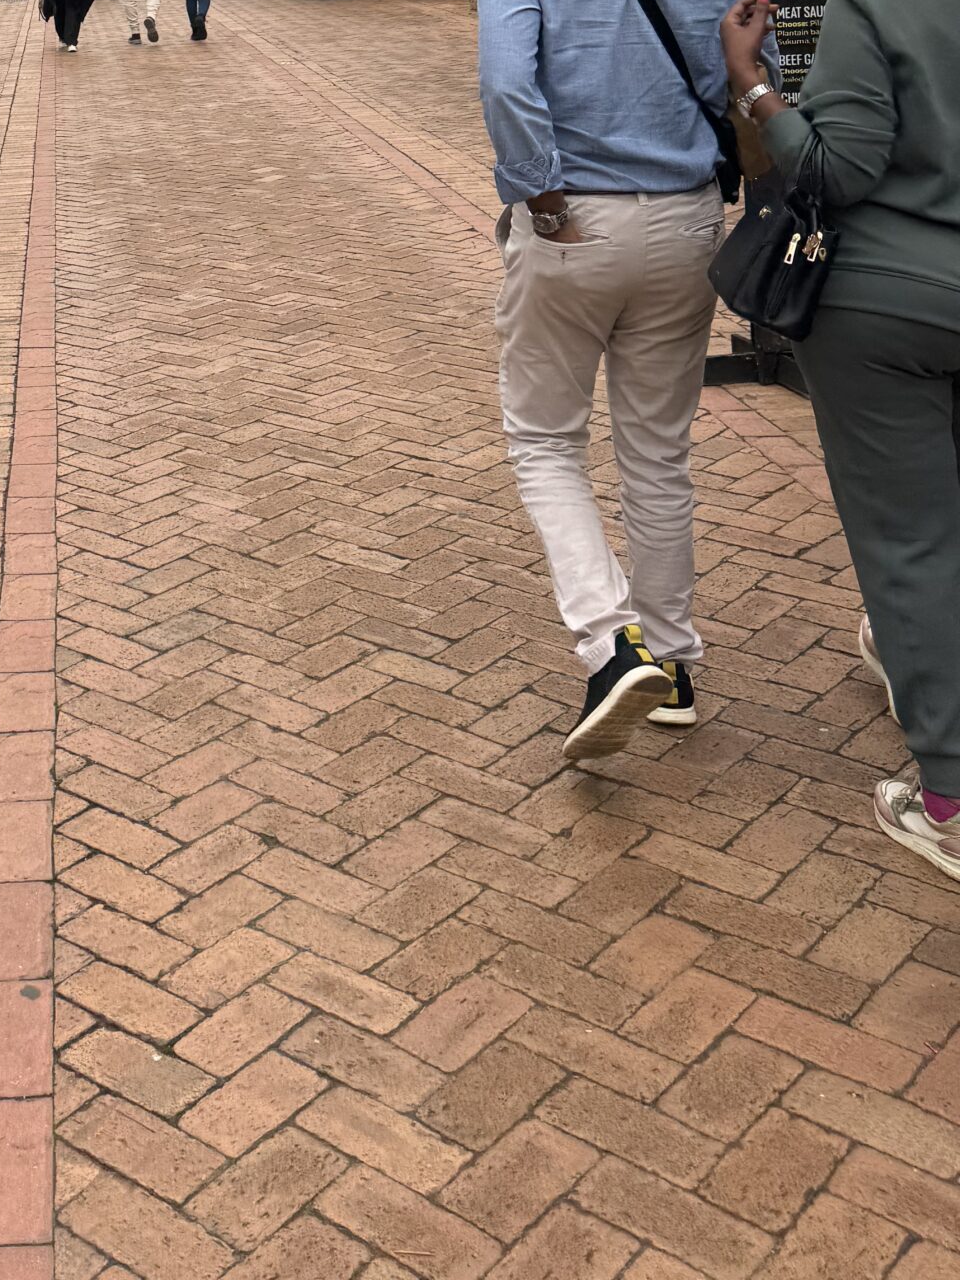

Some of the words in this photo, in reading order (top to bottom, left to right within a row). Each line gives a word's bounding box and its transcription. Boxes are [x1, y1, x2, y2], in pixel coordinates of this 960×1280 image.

[776, 6, 802, 19] MEAT
[803, 5, 825, 18] SAU
[779, 54, 803, 66] BEEF
